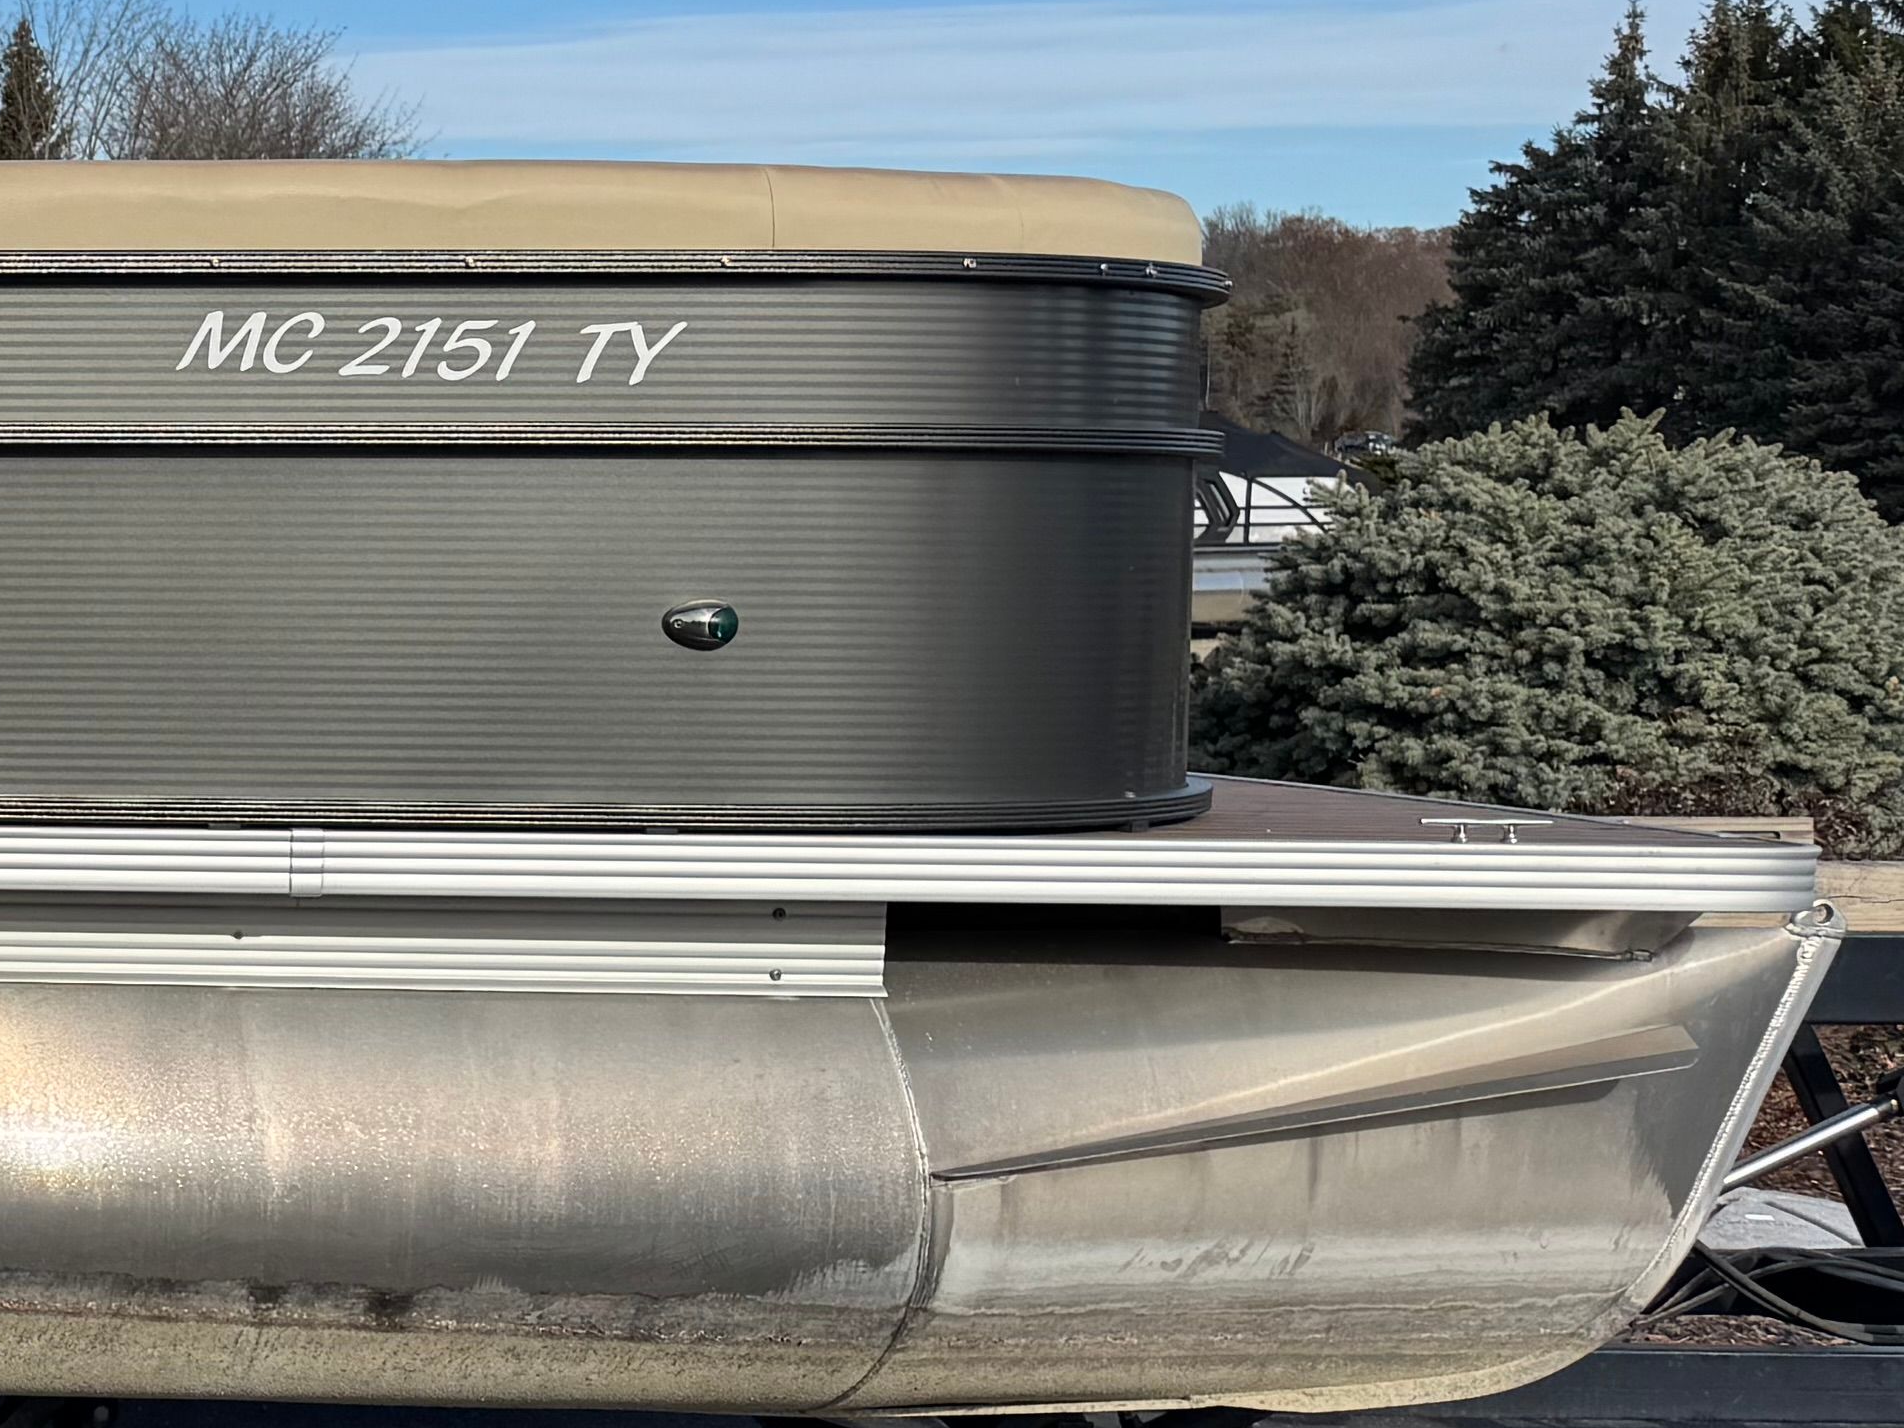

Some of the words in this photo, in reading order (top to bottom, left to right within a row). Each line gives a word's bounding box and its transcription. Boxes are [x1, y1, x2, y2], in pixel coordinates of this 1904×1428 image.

[176, 311, 325, 374] MC
[338, 317, 536, 381] 2151
[576, 321, 687, 385] TY
